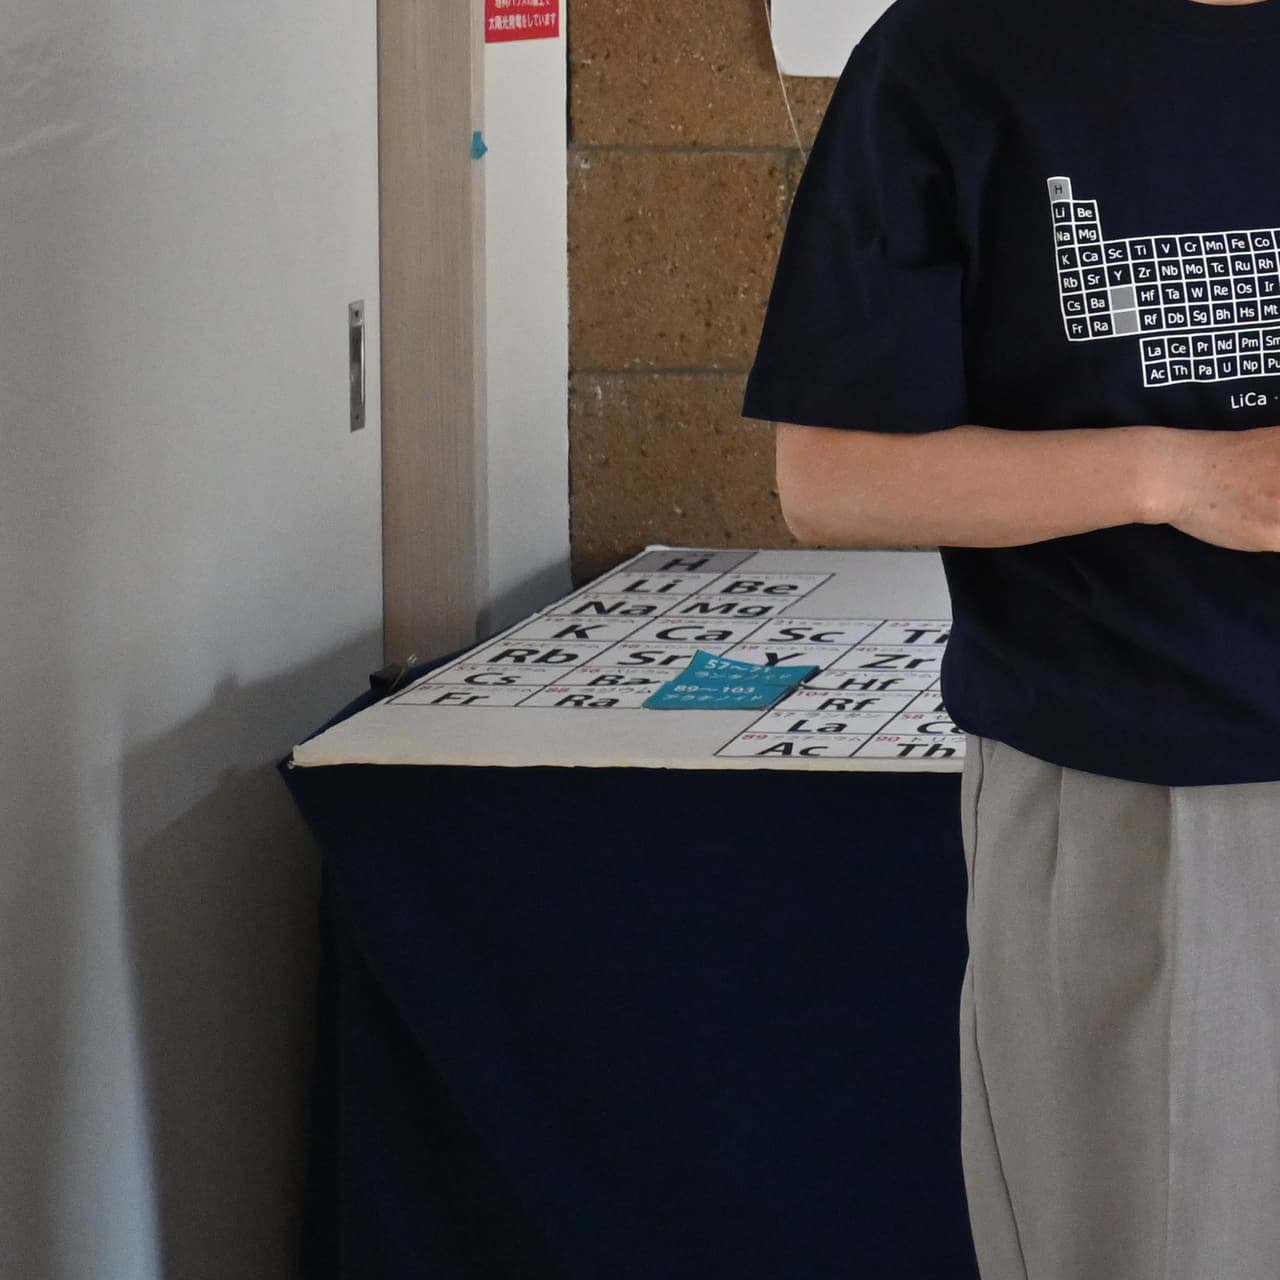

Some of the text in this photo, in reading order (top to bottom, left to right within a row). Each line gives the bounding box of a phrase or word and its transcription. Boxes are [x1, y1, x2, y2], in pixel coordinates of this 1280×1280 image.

[1078, 208, 1094, 218] Be
[1232, 239, 1244, 248] Fe
[1083, 252, 1098, 262] Ca
[1242, 359, 1259, 372] Np
[1231, 393, 1266, 408] LiCa
[573, 602, 658, 615] Na
[680, 602, 774, 619] Mg
[552, 625, 604, 638] K
[656, 626, 732, 641] Ca
